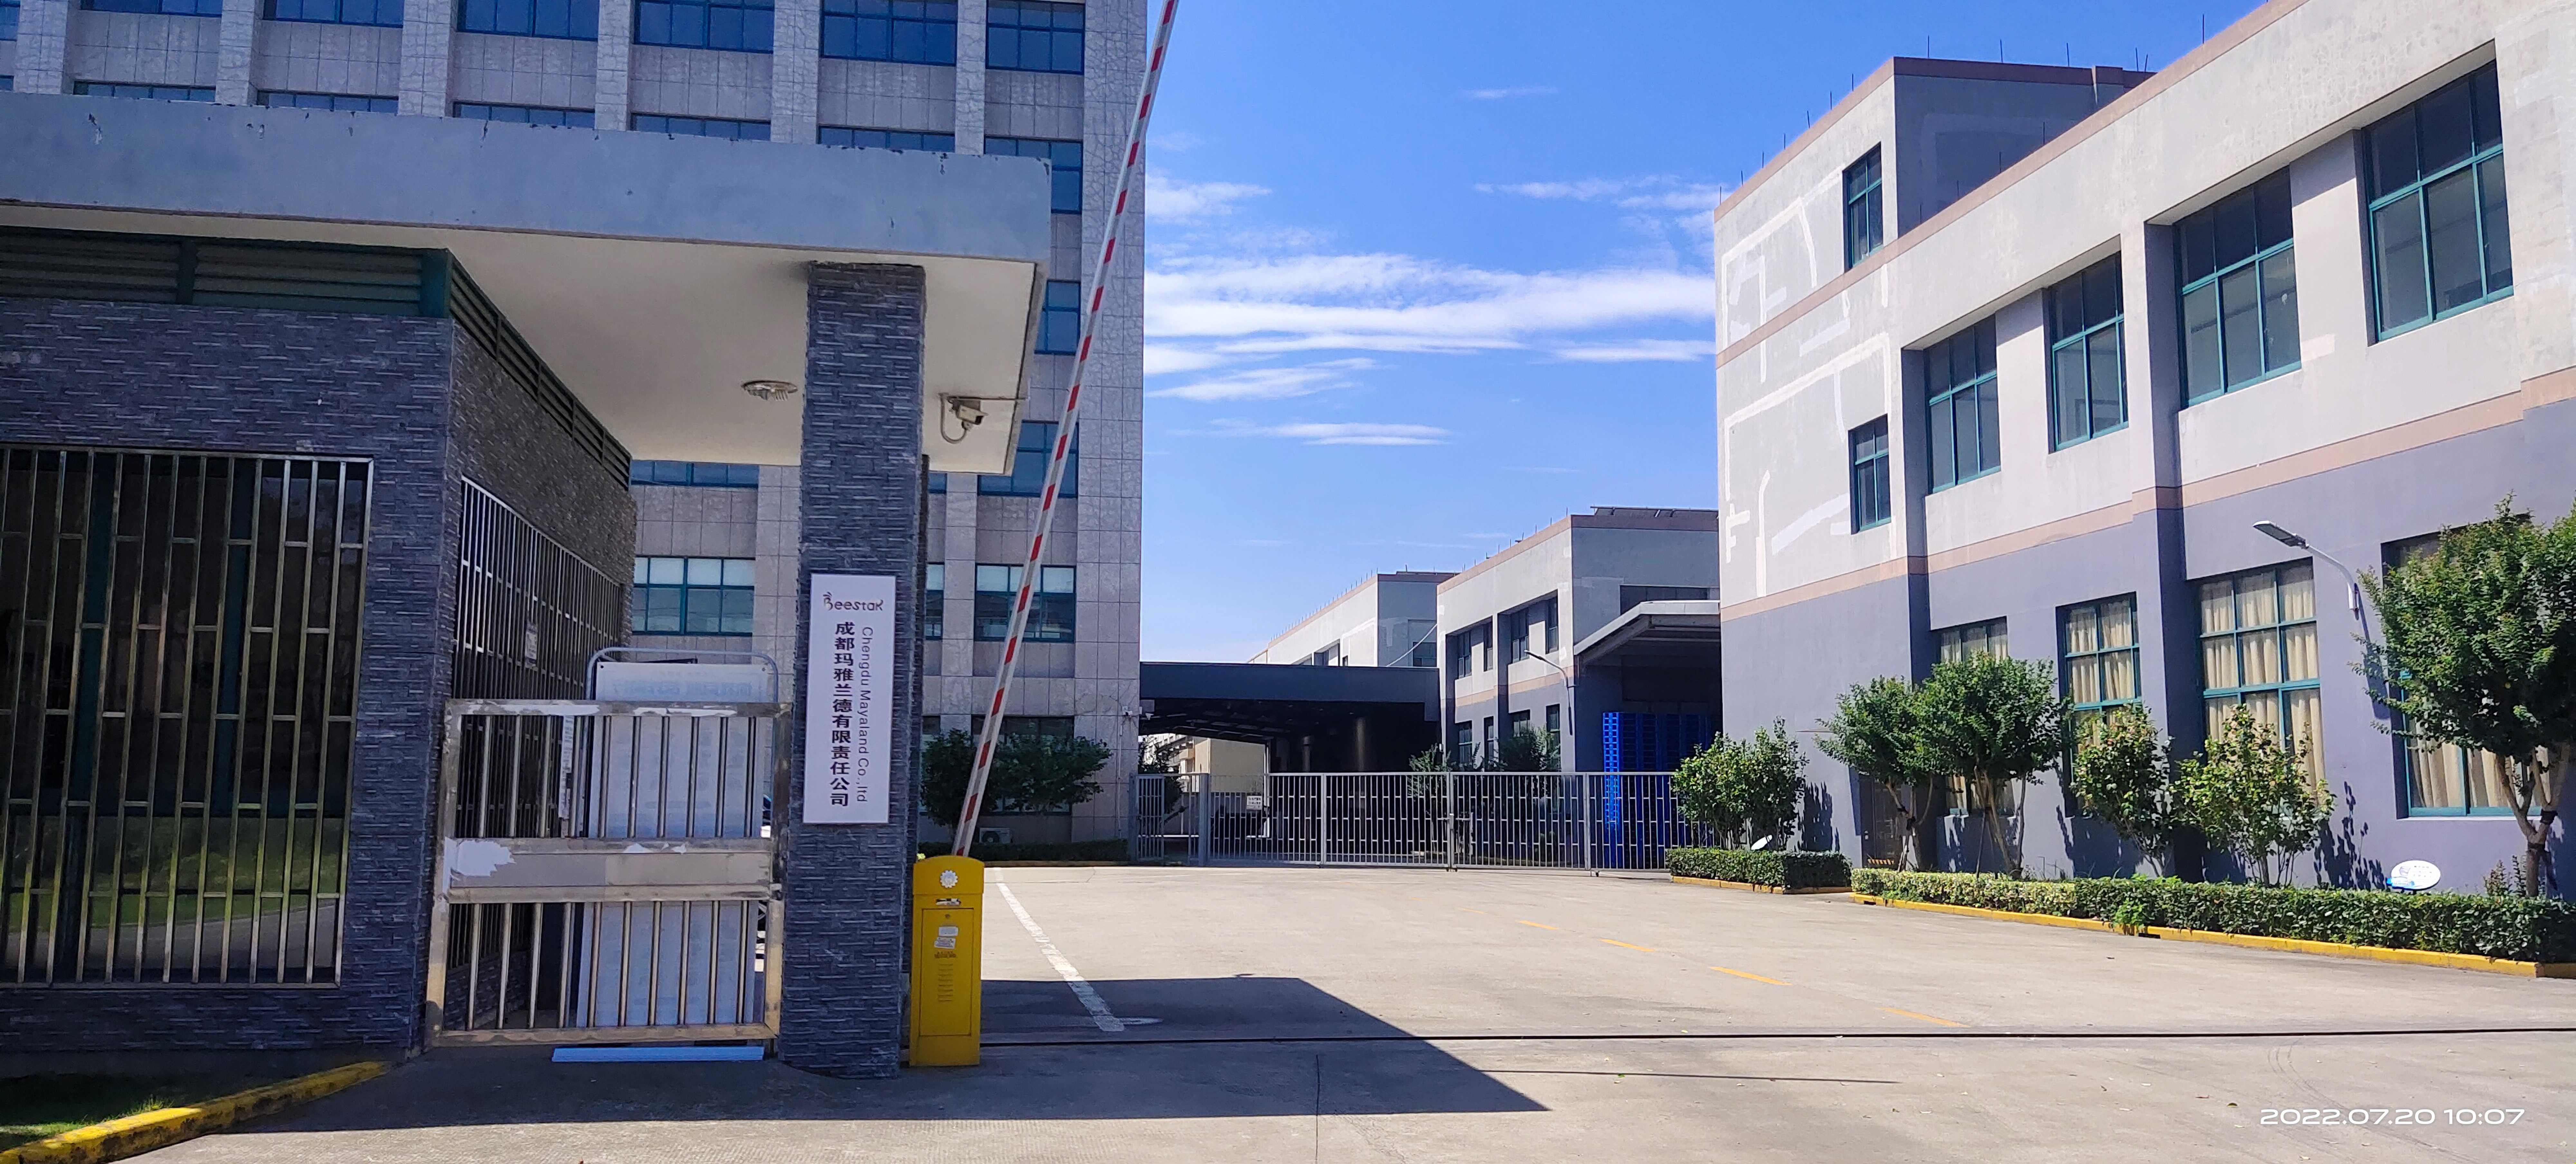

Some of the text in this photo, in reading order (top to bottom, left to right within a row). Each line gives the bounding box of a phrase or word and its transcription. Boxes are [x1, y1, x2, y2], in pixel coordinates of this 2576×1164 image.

[858, 627, 873, 685] Chengdu
[830, 622, 855, 806] 成都玛雅兰德有限责任公司
[857, 690, 871, 754] Mayaland
